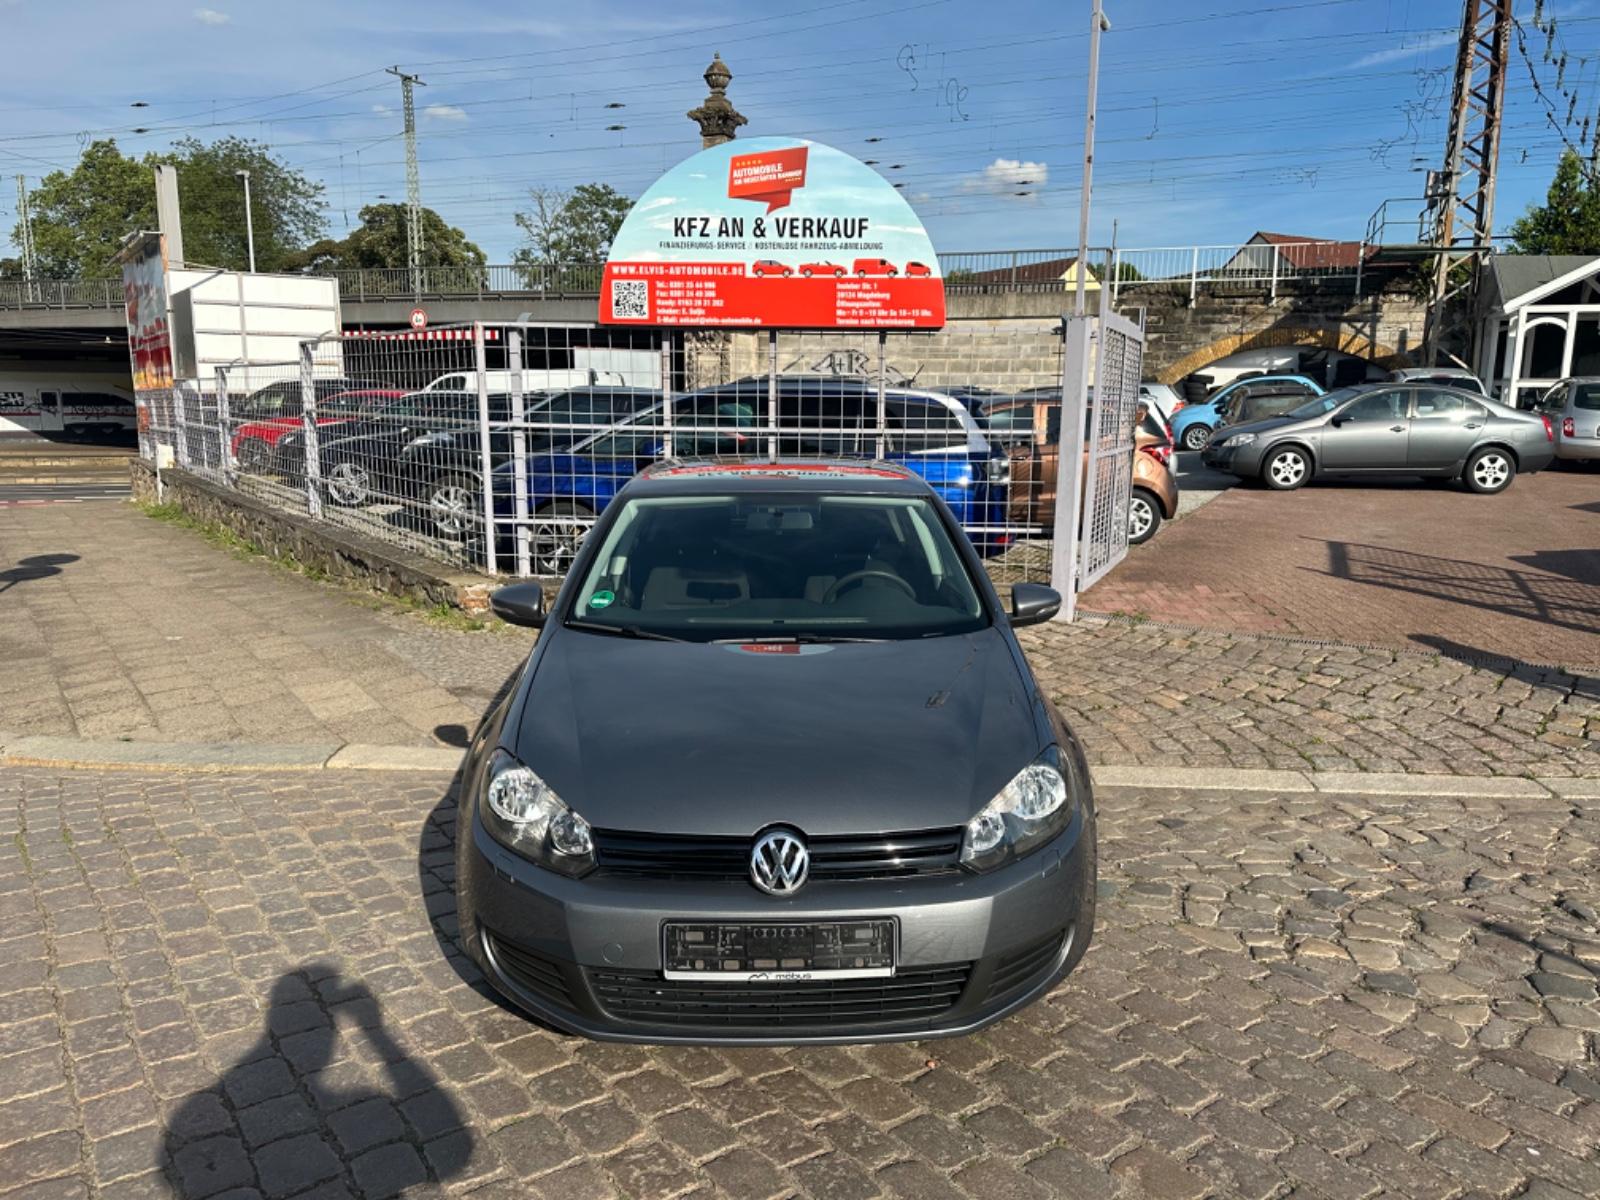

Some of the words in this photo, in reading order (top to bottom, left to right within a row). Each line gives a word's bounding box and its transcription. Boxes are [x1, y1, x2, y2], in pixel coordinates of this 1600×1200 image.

[733, 163, 784, 178] AUTOMOBILE
[674, 217, 711, 237] KFZ
[717, 217, 744, 237] AN
[752, 217, 767, 238] &
[775, 217, 869, 239] VERKAUF
[659, 241, 746, 250] FINANZIERUNGS-SERVICE
[755, 241, 798, 250] KOSTENLOSE
[799, 242, 883, 250] FAHRZEUG-ABMELDUNG
[611, 265, 744, 275] WWW.ELVIS-AUTOMOBILE.DE
[857, 291, 890, 300] Magdeburg
[751, 832, 809, 896] VW
